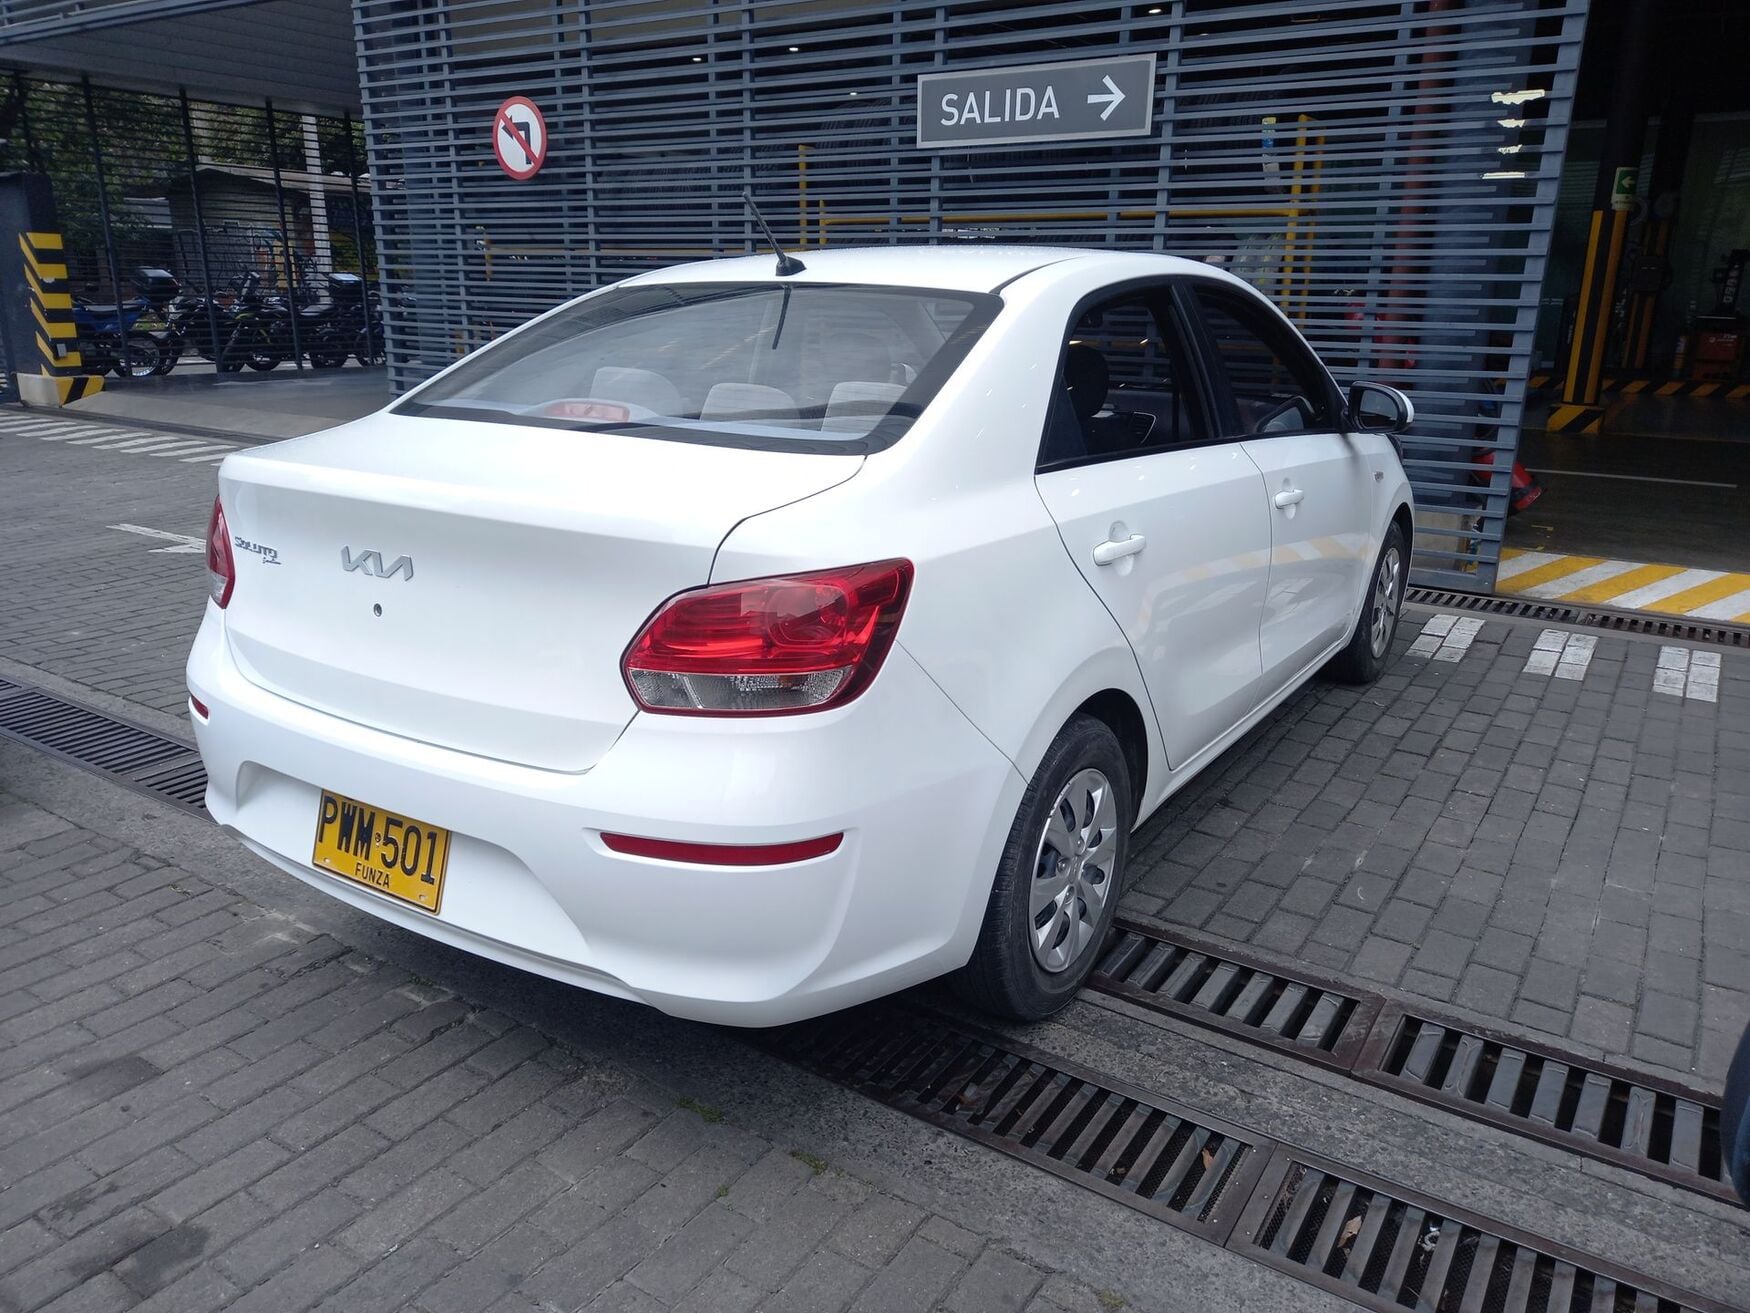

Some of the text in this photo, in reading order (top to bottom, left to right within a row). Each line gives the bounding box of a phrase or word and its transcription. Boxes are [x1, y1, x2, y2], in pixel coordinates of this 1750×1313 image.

[940, 85, 1060, 126] SALIDA
[341, 545, 414, 582] KIA
[318, 796, 437, 885] PWM 501
[355, 863, 390, 889] FUNZA
